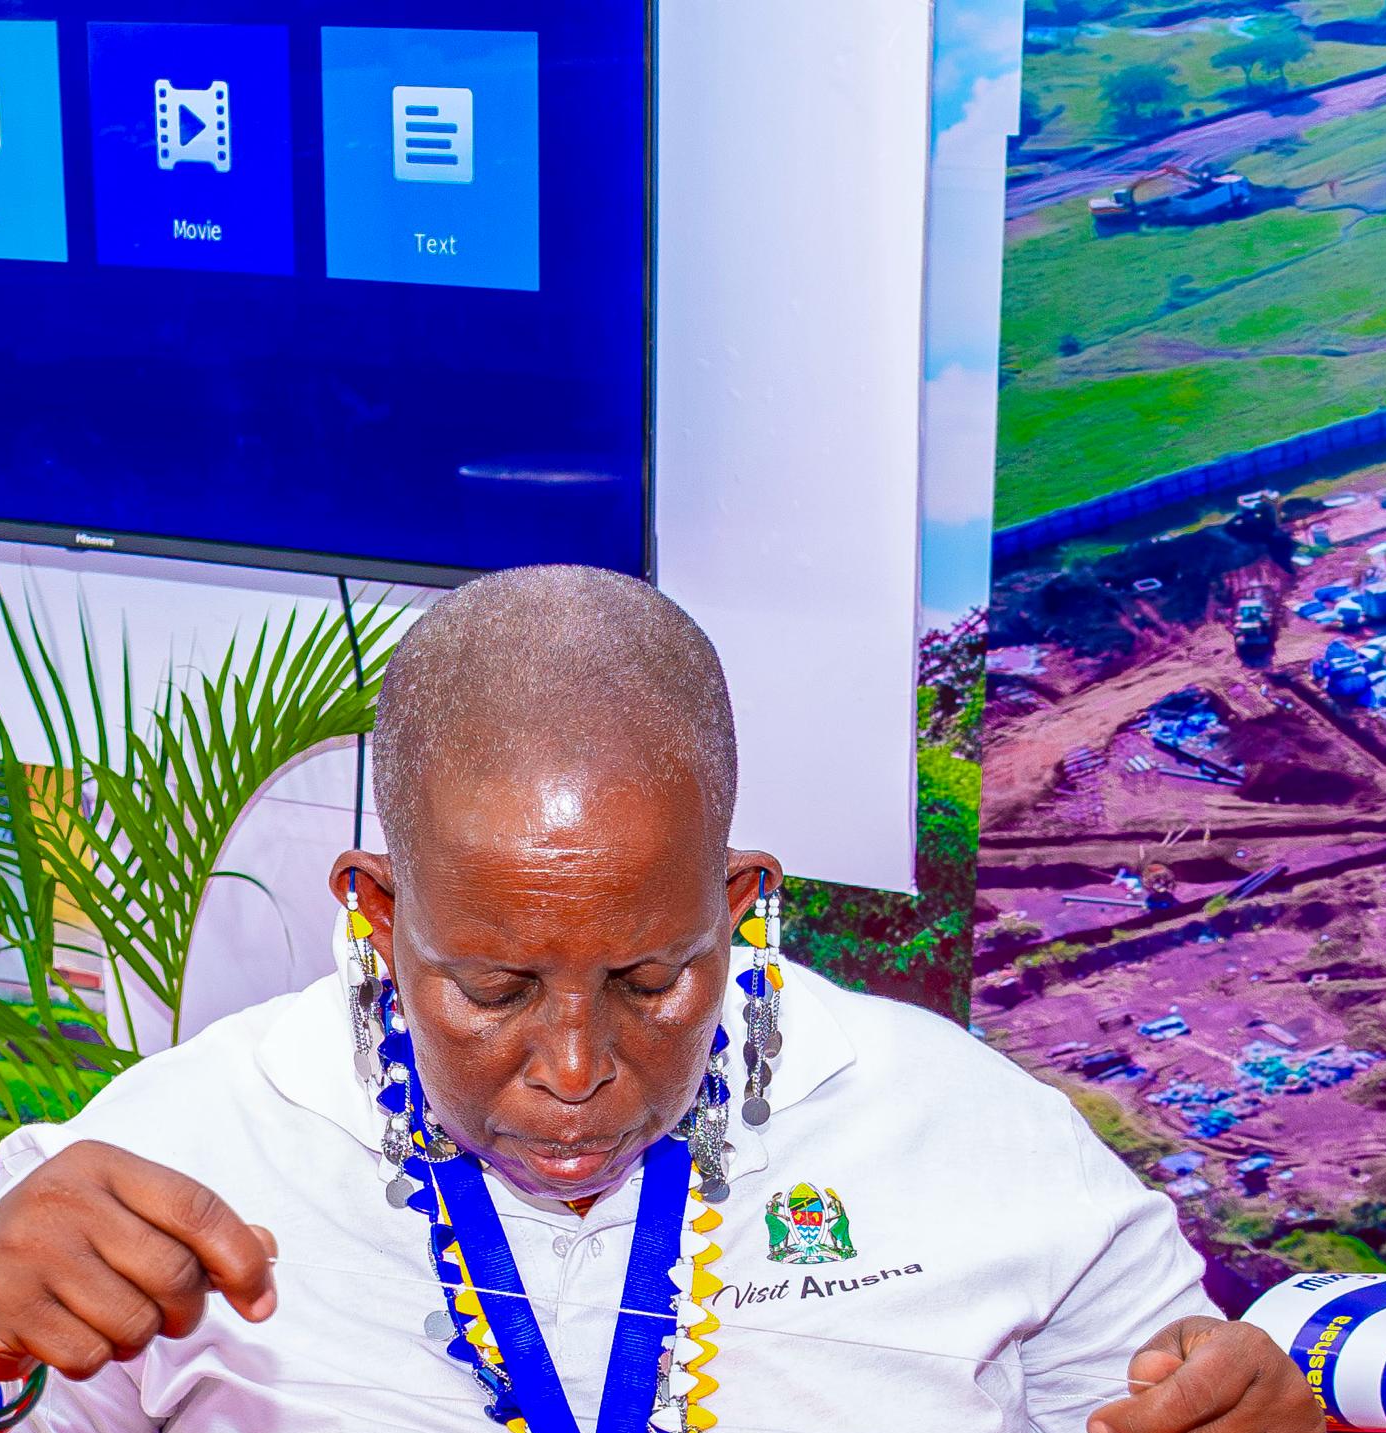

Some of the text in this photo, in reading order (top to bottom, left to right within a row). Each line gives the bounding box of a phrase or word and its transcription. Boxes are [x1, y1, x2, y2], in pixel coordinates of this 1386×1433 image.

[174, 219, 222, 241] Movie
[414, 233, 458, 255] Text
[712, 1261, 924, 1309] Visit Arusha
